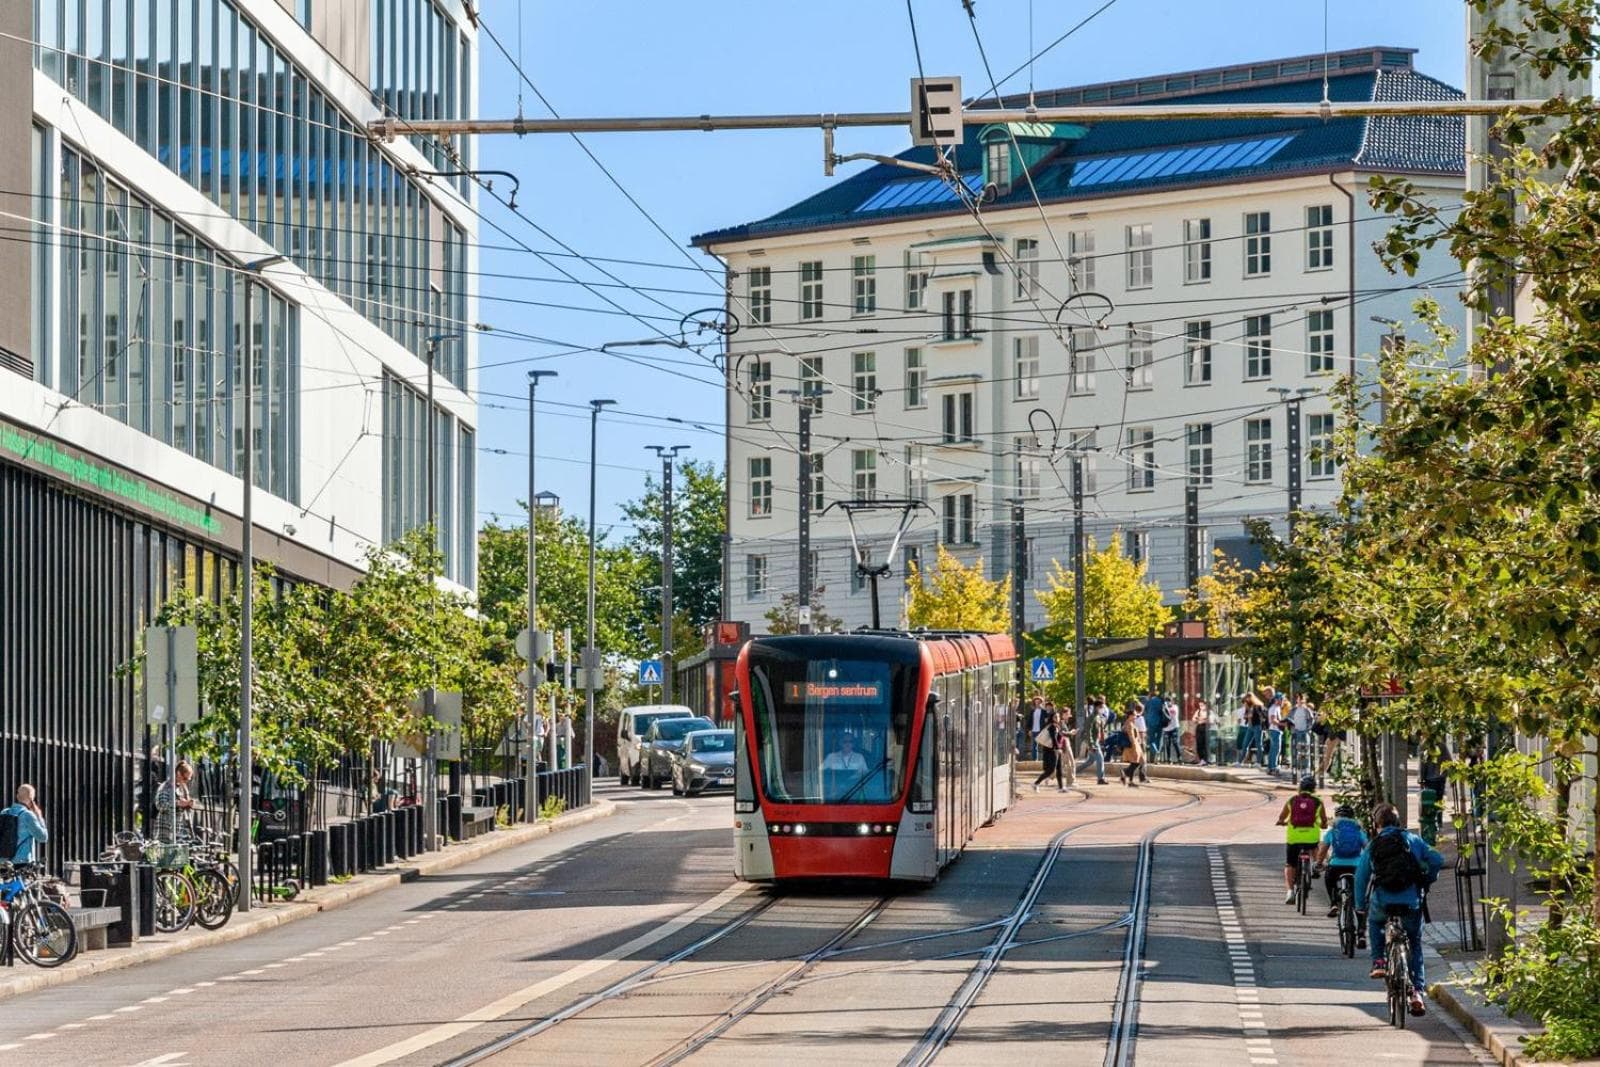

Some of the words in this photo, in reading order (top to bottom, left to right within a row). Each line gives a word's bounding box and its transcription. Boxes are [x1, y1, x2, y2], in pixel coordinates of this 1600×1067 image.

[919, 83, 955, 138] E
[807, 683, 840, 699] Bergen
[841, 683, 877, 697] sentrum
